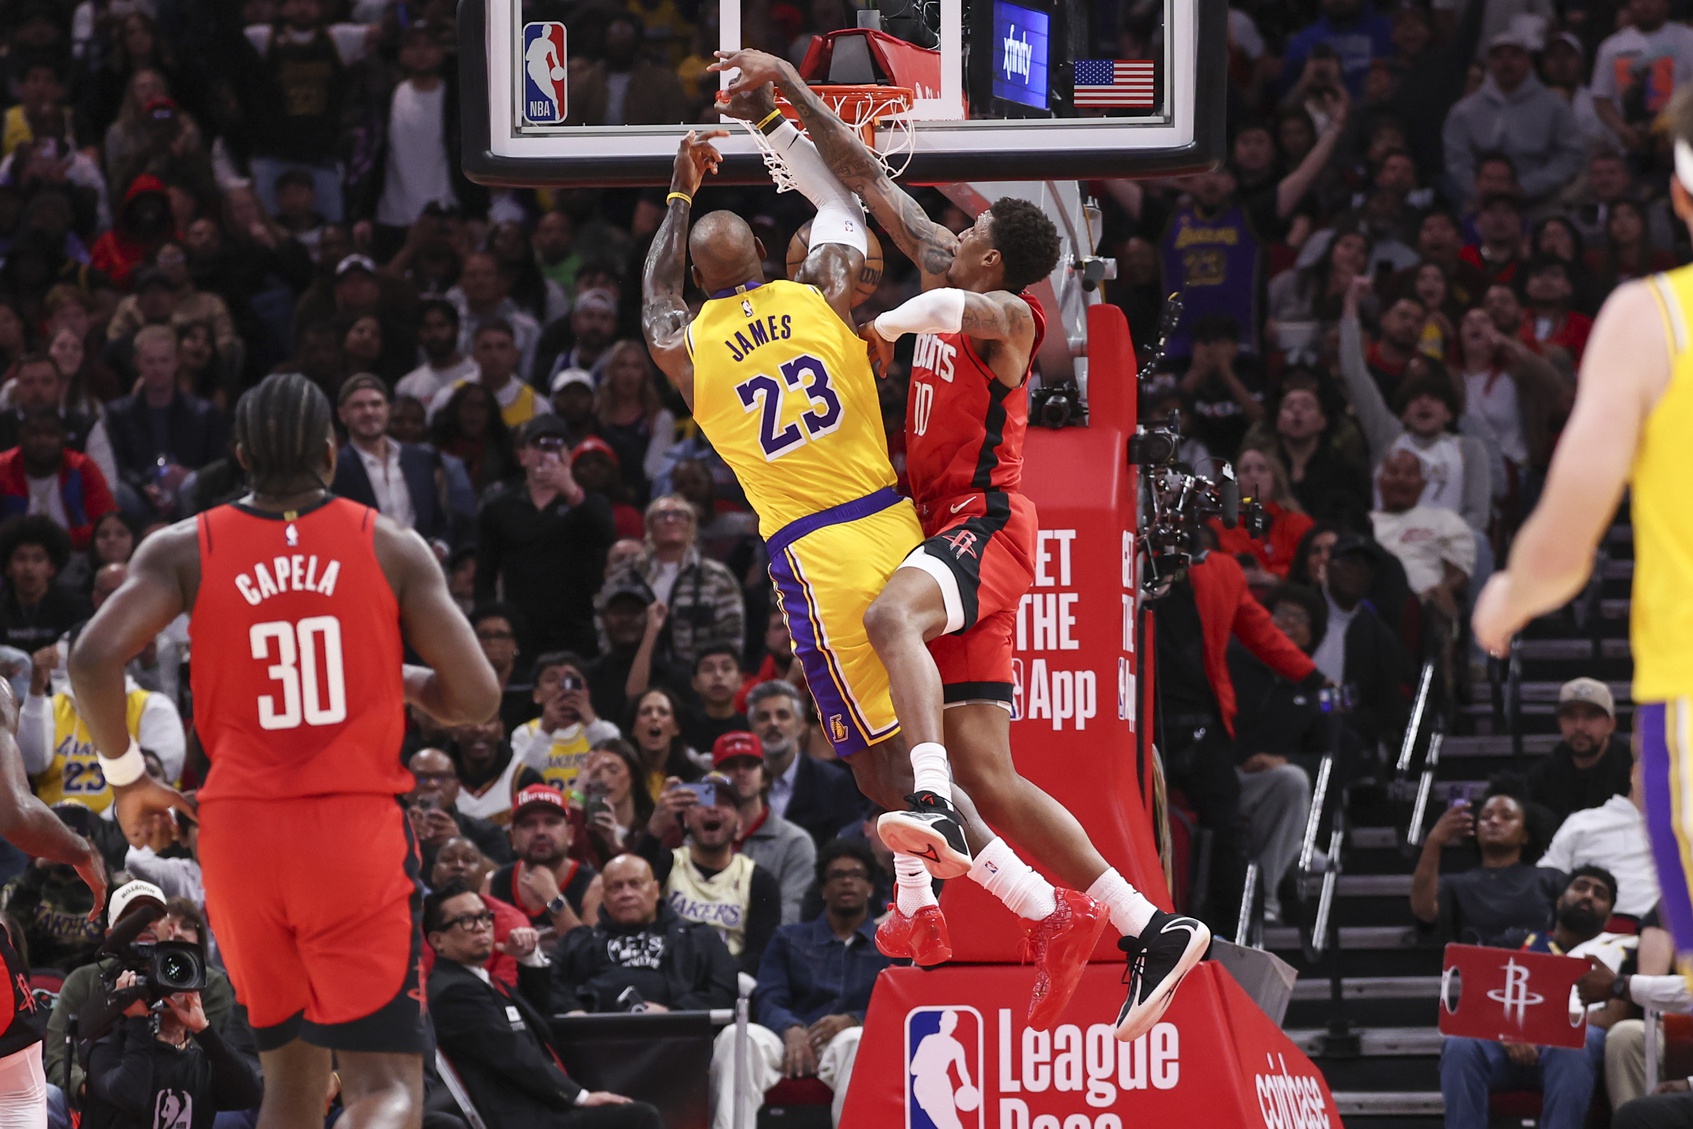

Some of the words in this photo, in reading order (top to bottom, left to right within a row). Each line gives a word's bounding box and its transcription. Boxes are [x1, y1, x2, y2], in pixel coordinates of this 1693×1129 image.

[1003, 24, 1033, 85] xfinity
[530, 101, 550, 117] NBA
[724, 314, 792, 362] JAMES
[733, 353, 846, 462] 23
[914, 381, 934, 436] 10
[235, 554, 340, 606] CAPELA
[1030, 529, 1076, 586] ET
[1017, 593, 1079, 650] THE
[249, 615, 347, 730] 30
[1028, 658, 1096, 730] App
[63, 762, 106, 794] 23
[33, 900, 102, 940] LAKERS
[669, 891, 740, 927] LAKERS
[999, 1008, 1180, 1108] League
[1255, 1052, 1331, 1129] coinbase
